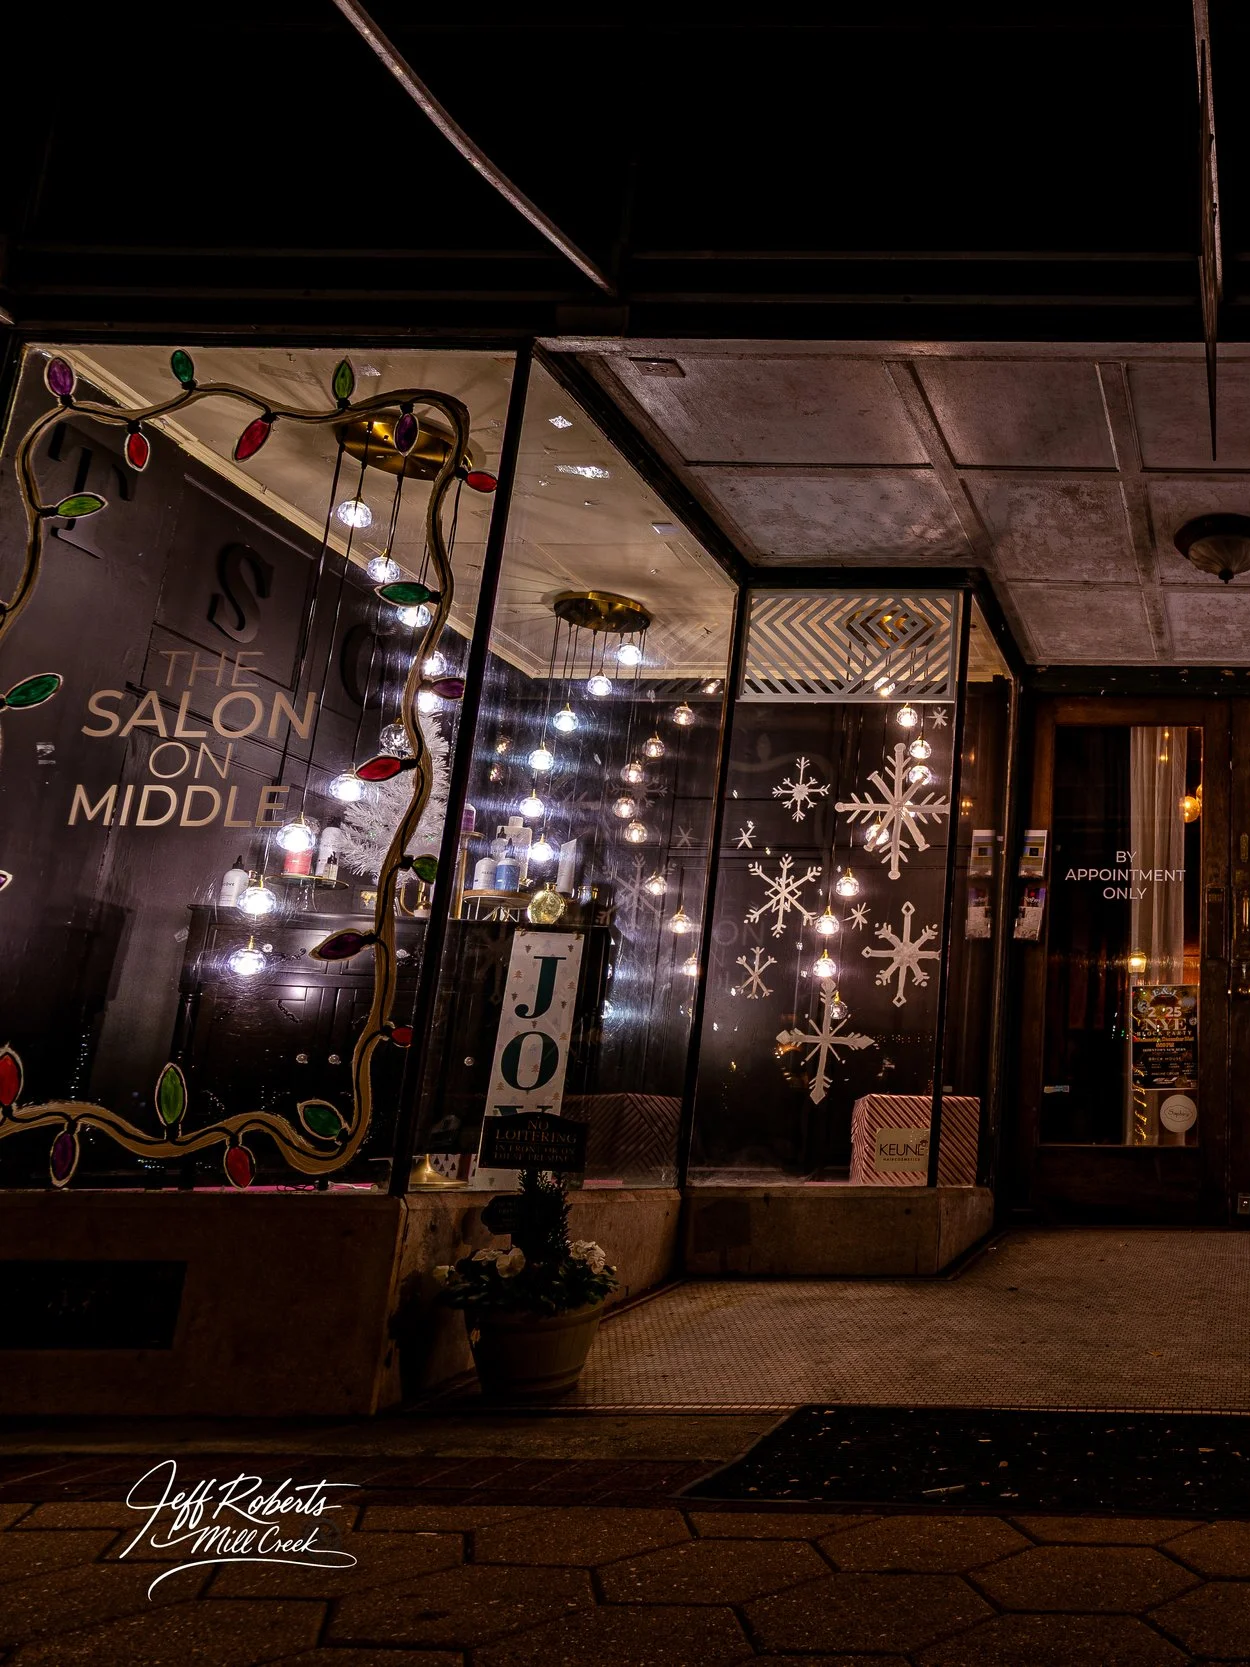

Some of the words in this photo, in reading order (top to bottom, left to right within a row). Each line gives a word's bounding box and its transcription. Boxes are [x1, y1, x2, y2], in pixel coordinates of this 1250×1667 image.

[206, 541, 275, 644] S
[159, 650, 265, 687] THE
[81, 689, 317, 739] SALON
[148, 741, 233, 779] ON
[67, 784, 290, 828] MIDDLE
[1115, 850, 1137, 863] BY
[1064, 868, 1186, 882] APPOINTMENT
[1102, 887, 1147, 900] ONLY
[1144, 1018, 1187, 1031] NYE
[493, 955, 567, 1117] JO
[527, 1119, 550, 1130] NO
[495, 1128, 578, 1144] LOITERING
[879, 1143, 925, 1156] KEUNE
